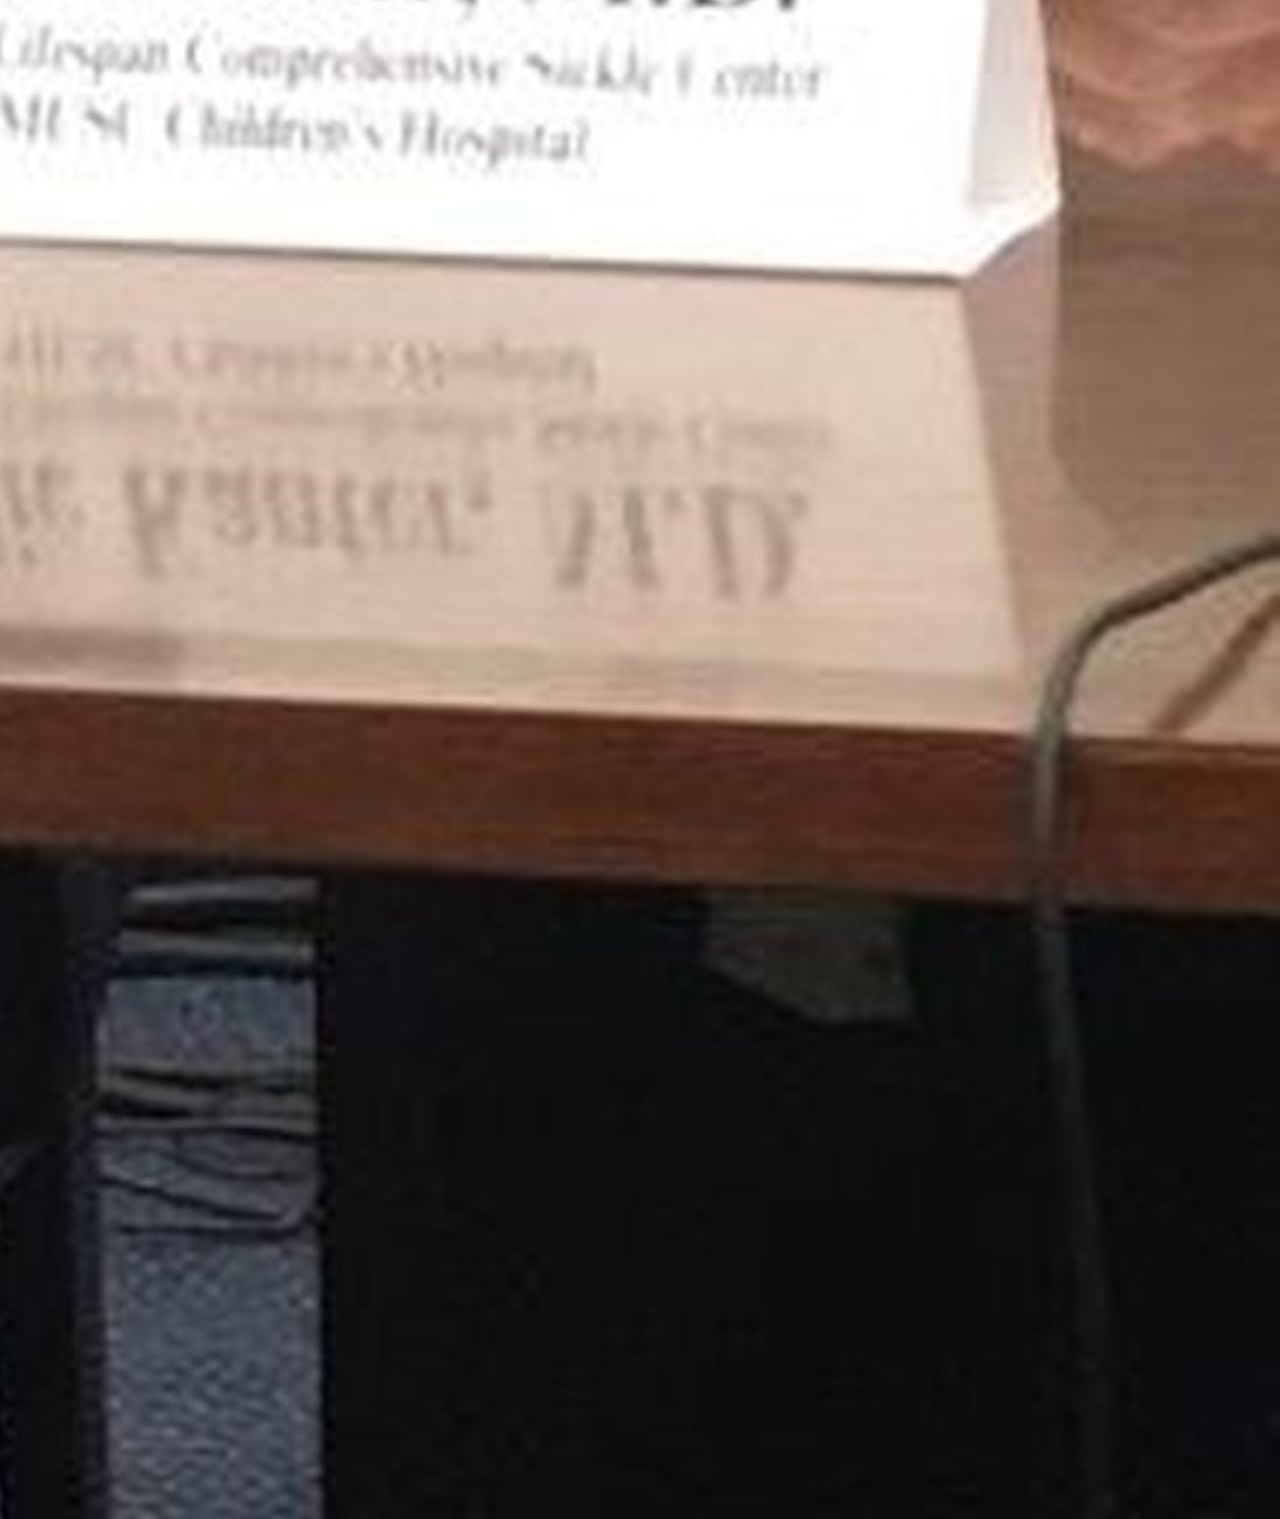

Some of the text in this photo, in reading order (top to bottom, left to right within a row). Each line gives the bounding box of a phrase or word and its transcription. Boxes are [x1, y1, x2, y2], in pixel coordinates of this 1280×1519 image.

[185, 32, 502, 90] Comprehensive
[676, 53, 823, 100] Center
[400, 109, 591, 169] Hospital
